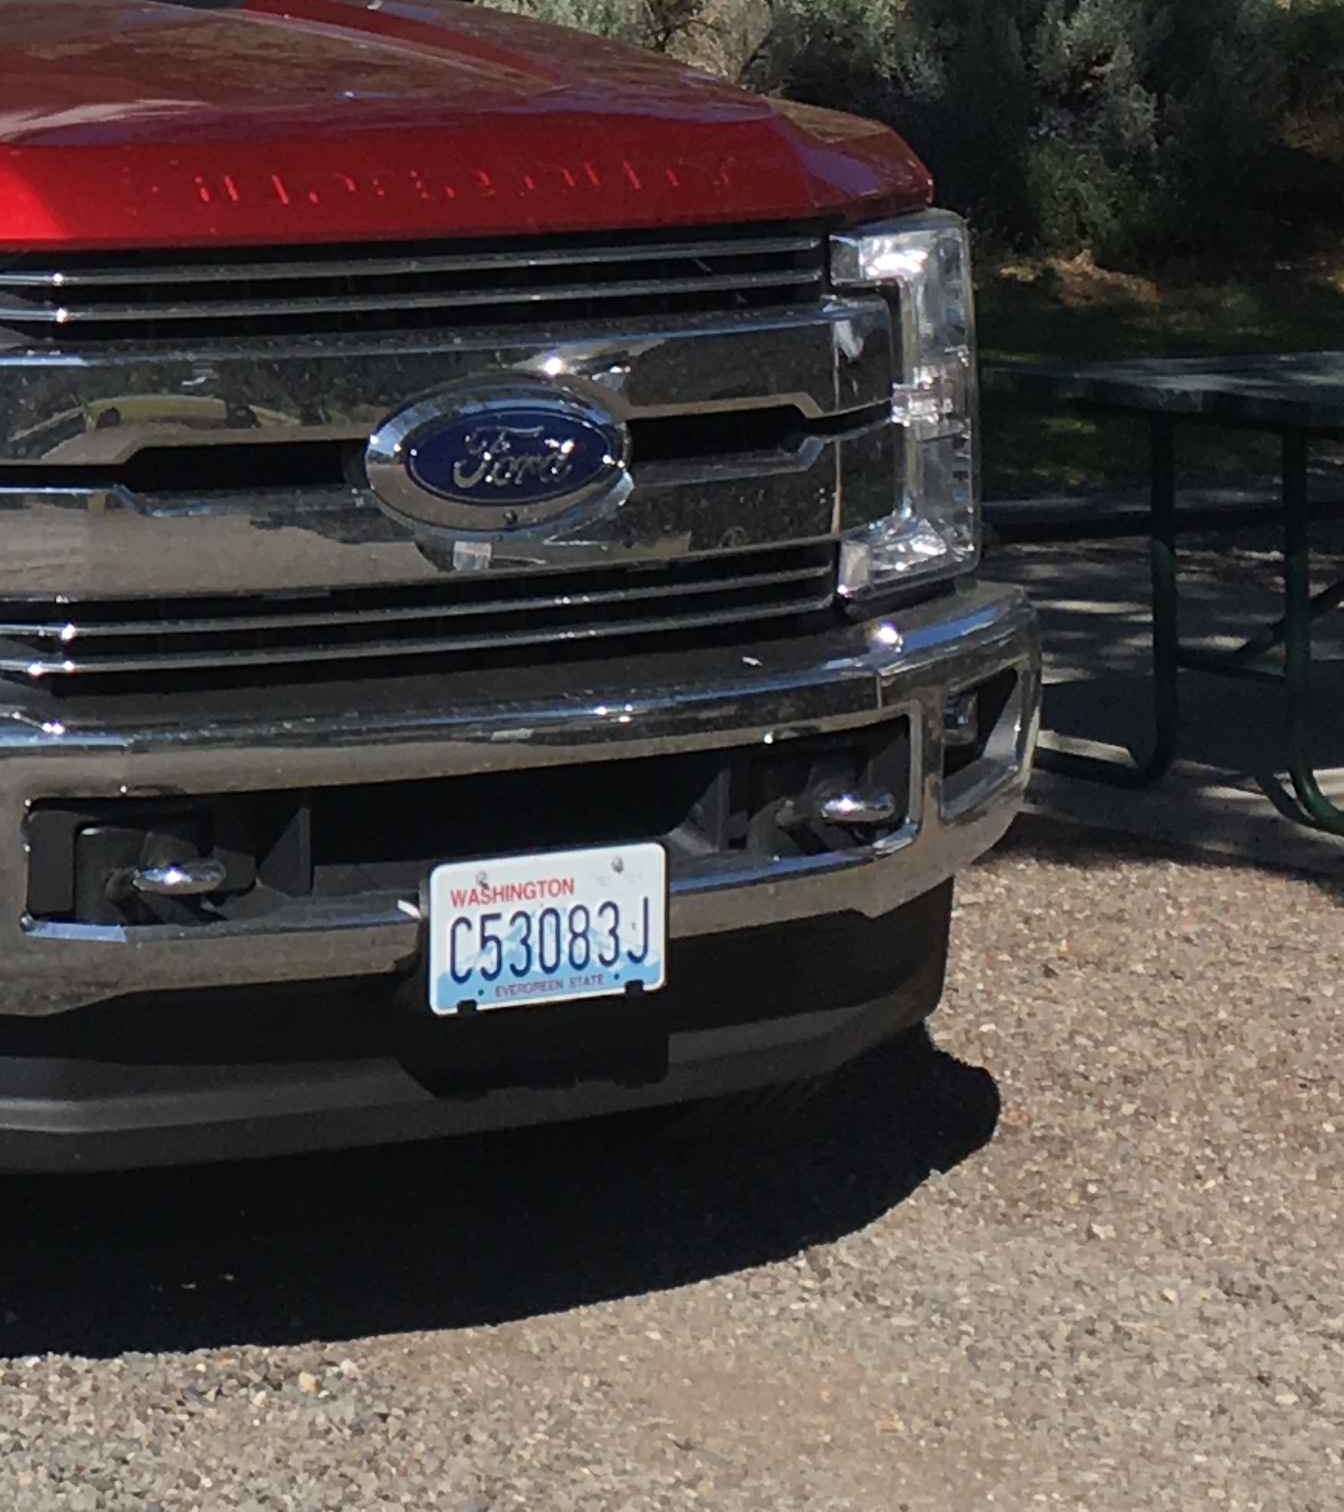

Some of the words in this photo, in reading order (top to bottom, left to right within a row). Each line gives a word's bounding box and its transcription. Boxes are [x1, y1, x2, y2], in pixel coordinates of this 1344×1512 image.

[453, 426, 573, 489] Ford
[450, 877, 575, 908] WASHINGTON
[449, 896, 650, 984] C53083J
[495, 979, 564, 997] EVERGREEN
[569, 973, 604, 989] STATE
